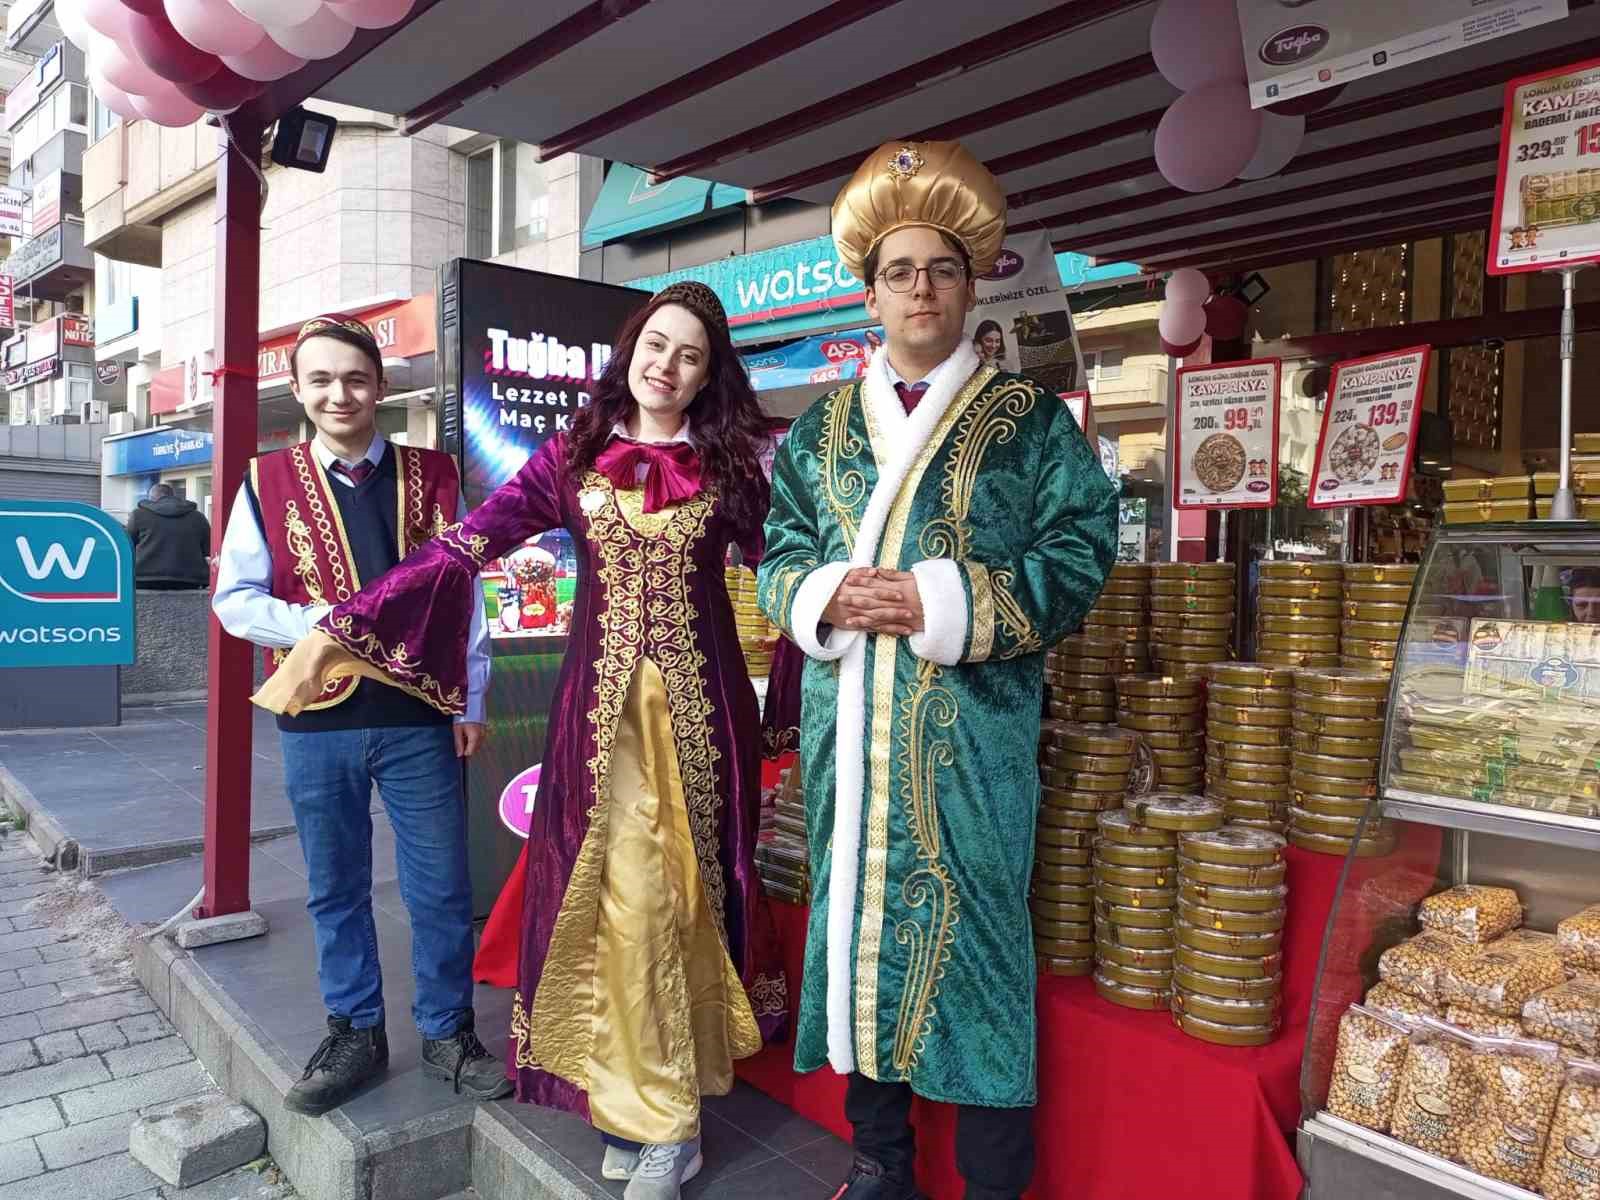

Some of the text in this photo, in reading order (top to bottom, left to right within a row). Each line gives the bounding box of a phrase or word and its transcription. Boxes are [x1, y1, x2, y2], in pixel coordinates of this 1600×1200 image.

[736, 259, 858, 309] watso
[1188, 379, 1268, 397] KAMPANYA
[1340, 366, 1414, 390] KAMPANYA
[492, 382, 568, 407] Lezzet
[500, 408, 546, 434] Maç
